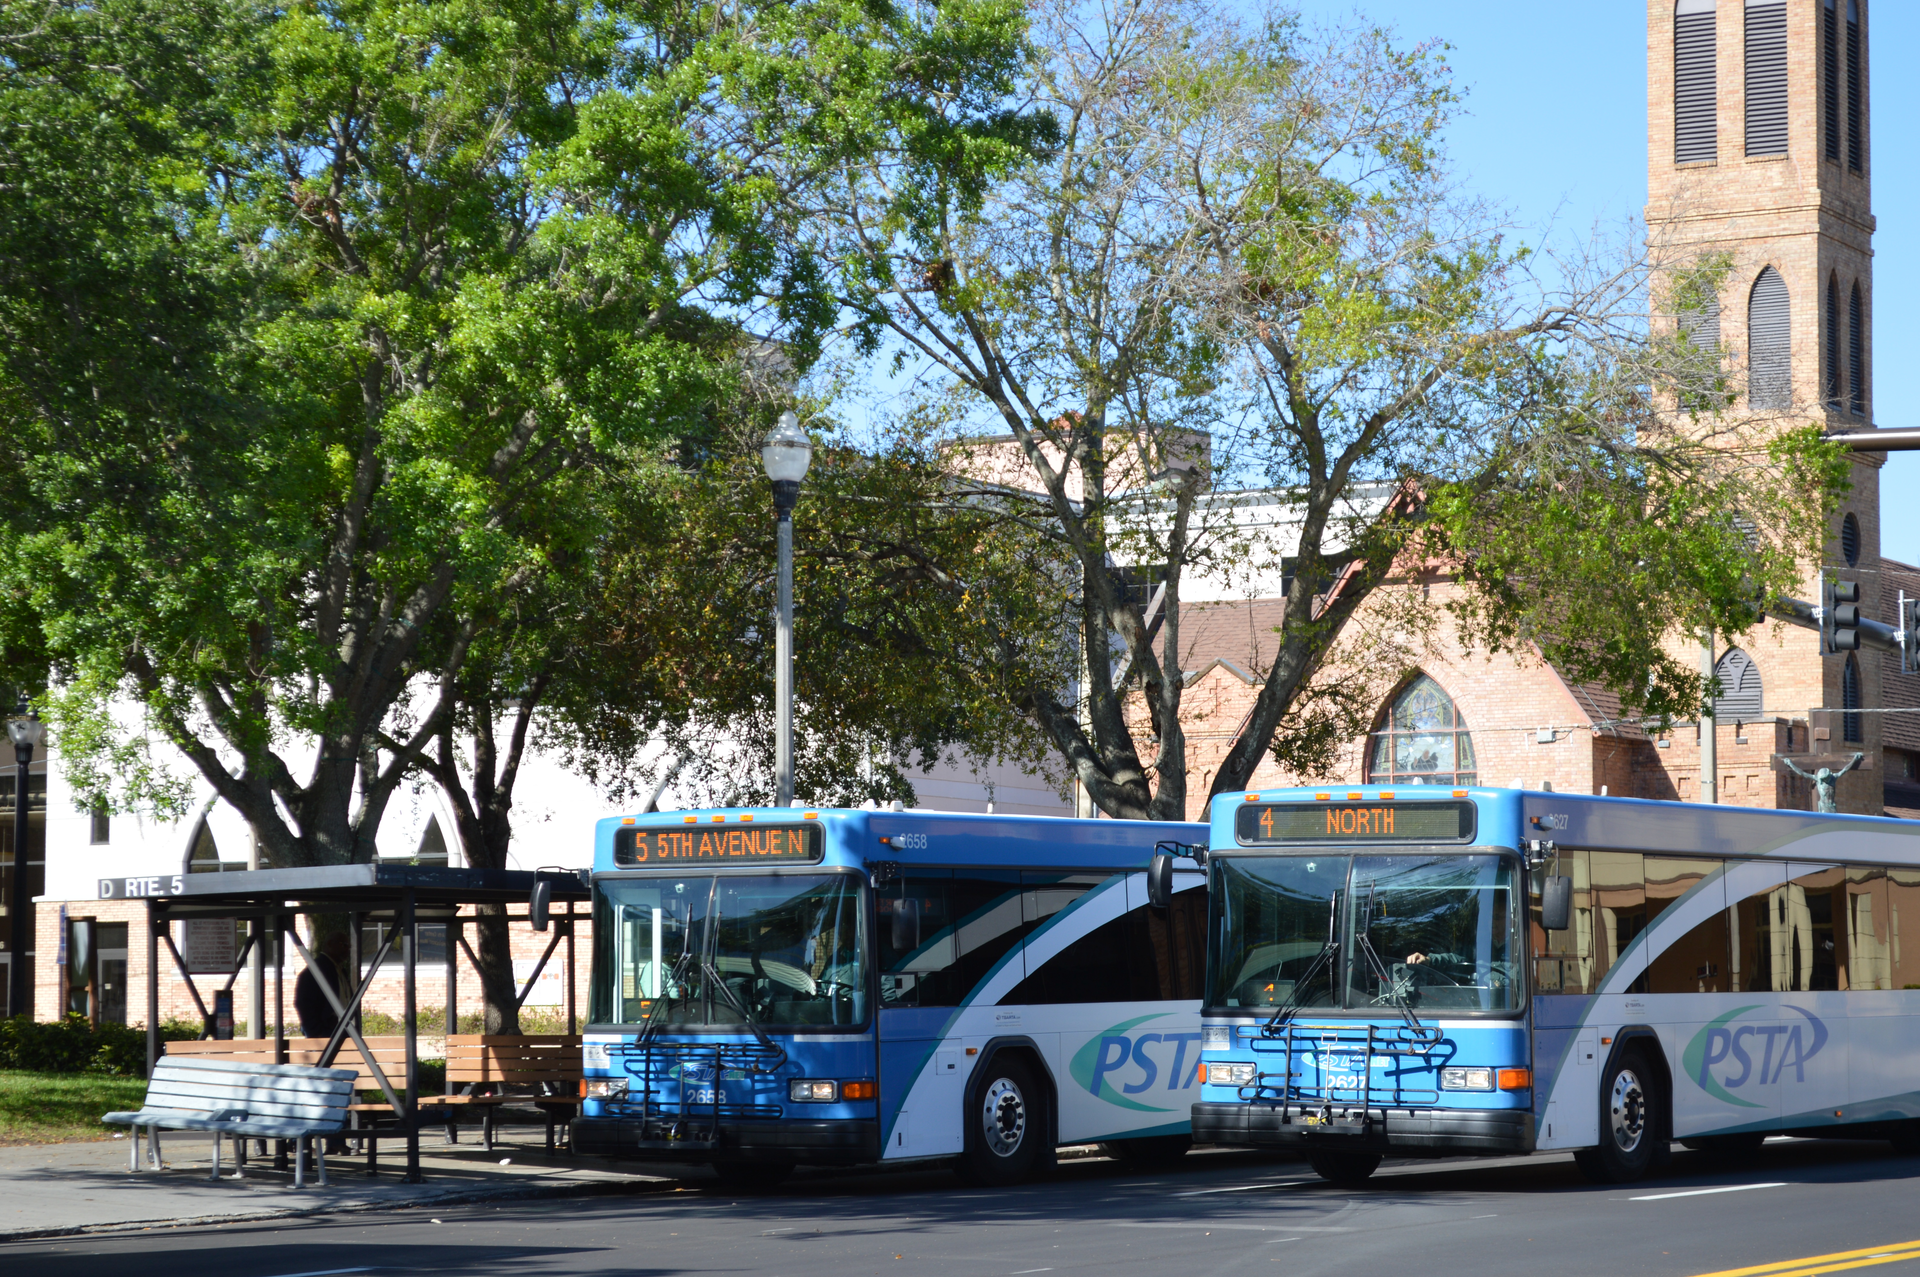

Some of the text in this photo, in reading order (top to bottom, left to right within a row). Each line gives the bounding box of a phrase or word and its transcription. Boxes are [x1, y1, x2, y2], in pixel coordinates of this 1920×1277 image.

[1260, 807, 1394, 838] 4 NORTH
[636, 829, 802, 862] 5 5TH AVENUE N
[101, 876, 184, 899] D RTE. 5
[1698, 1025, 1805, 1090] PSTA
[687, 1089, 727, 1104] 2658
[1327, 1075, 1368, 1092] 2627
